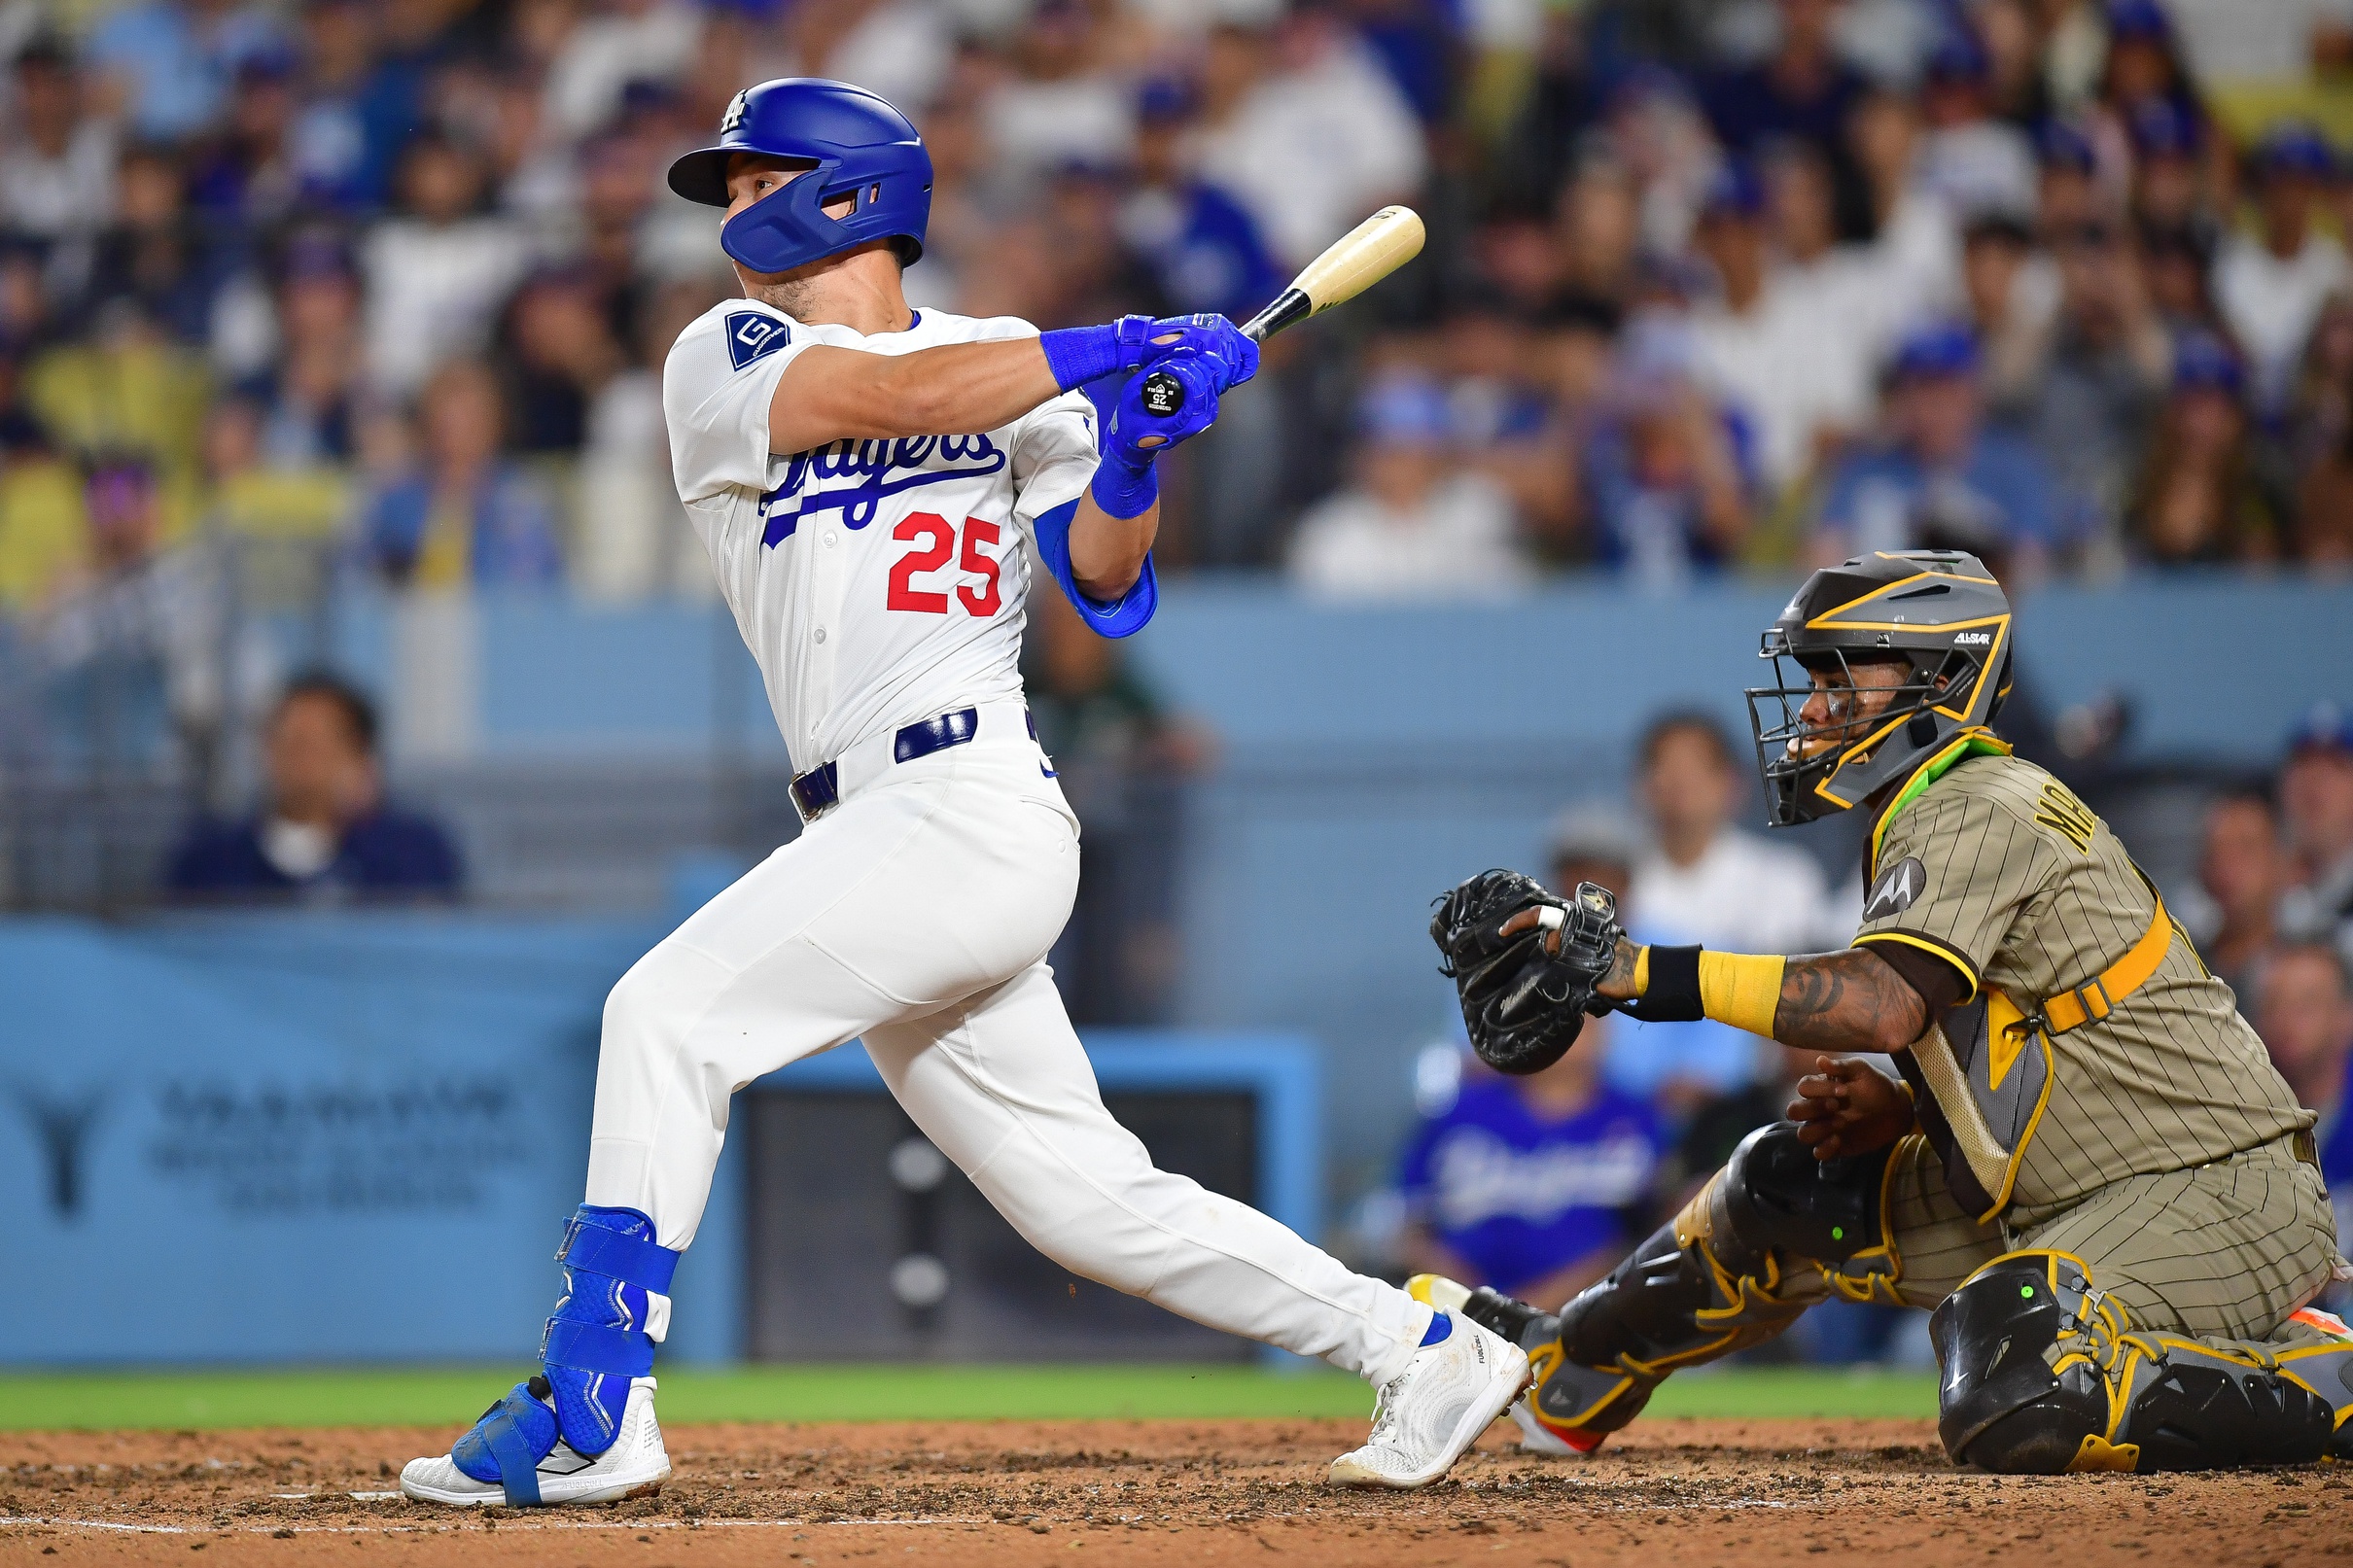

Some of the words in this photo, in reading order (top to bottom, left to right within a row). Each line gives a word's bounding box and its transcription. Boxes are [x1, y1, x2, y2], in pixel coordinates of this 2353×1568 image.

[737, 316, 771, 346] G
[1152, 393, 1167, 405] 25
[887, 511, 1002, 616] 25
[1953, 632, 1990, 645] ALL-STAR
